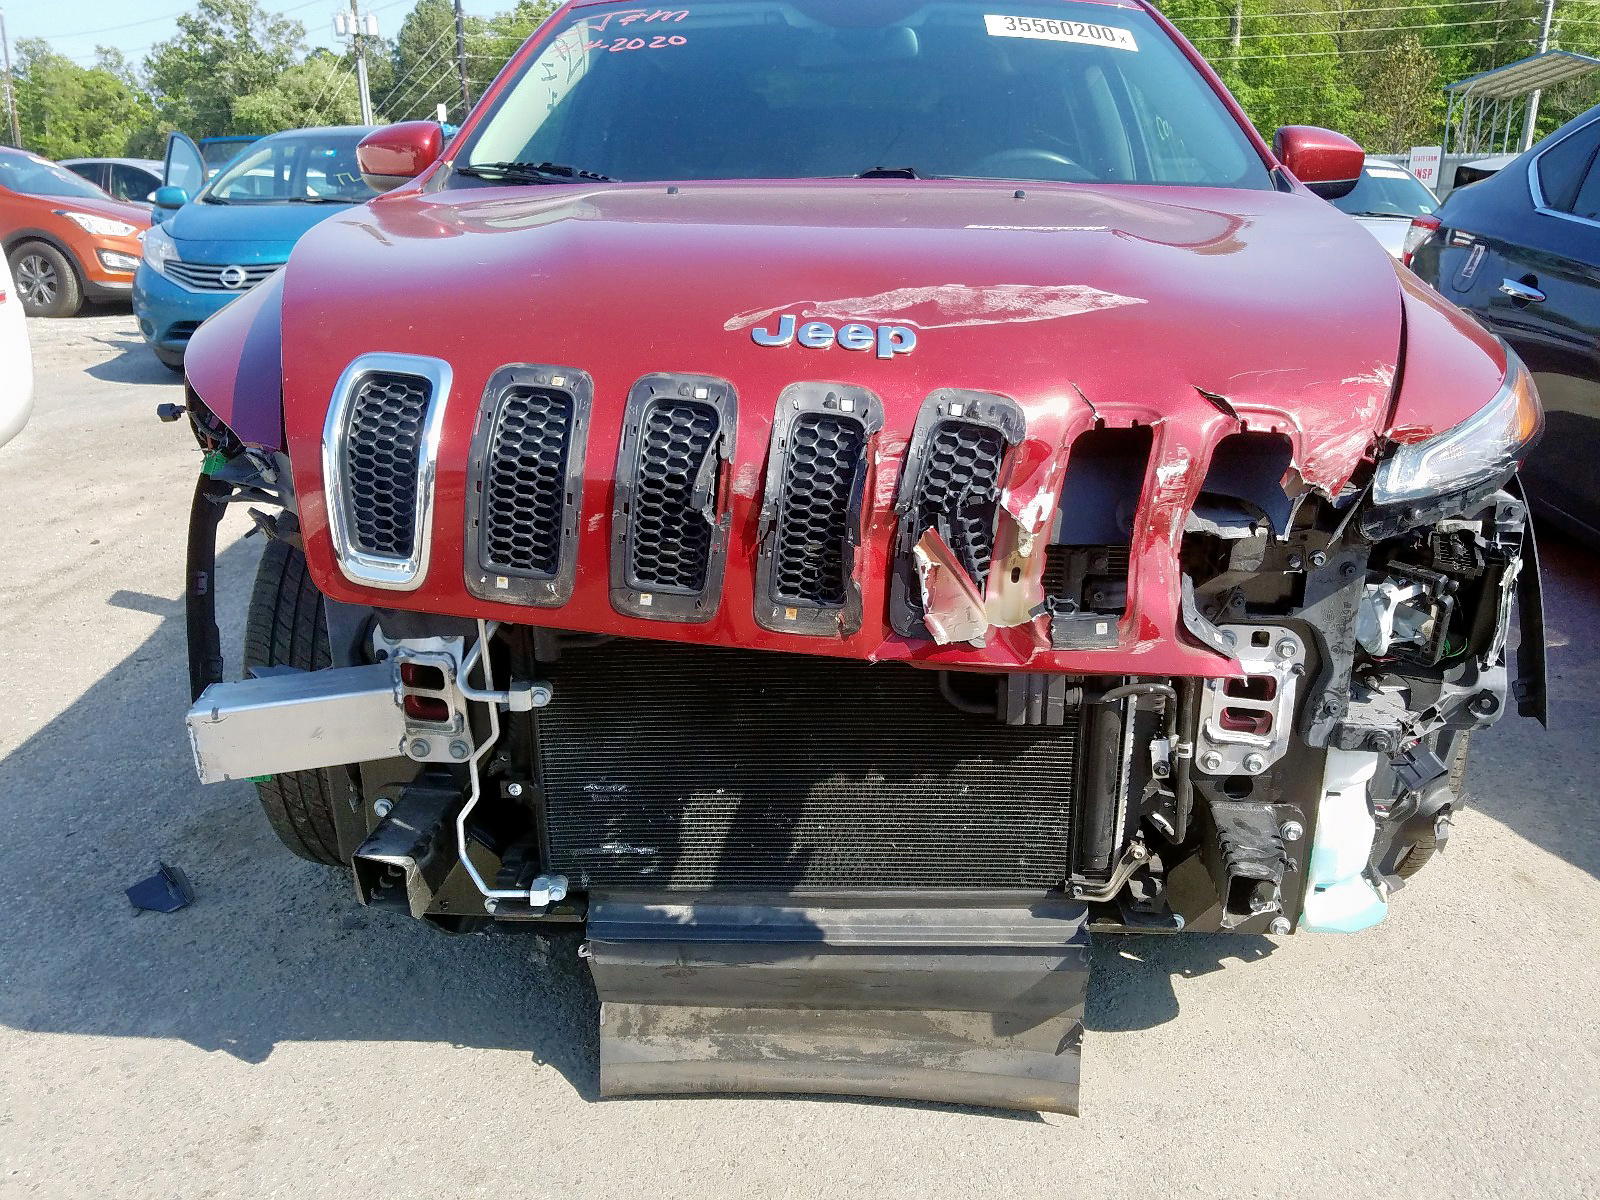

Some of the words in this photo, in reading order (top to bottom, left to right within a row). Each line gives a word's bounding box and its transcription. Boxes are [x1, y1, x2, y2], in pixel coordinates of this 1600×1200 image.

[1004, 16, 1115, 42] 35560200
[1414, 168, 1433, 179] INSP
[751, 314, 917, 360] Jeep
